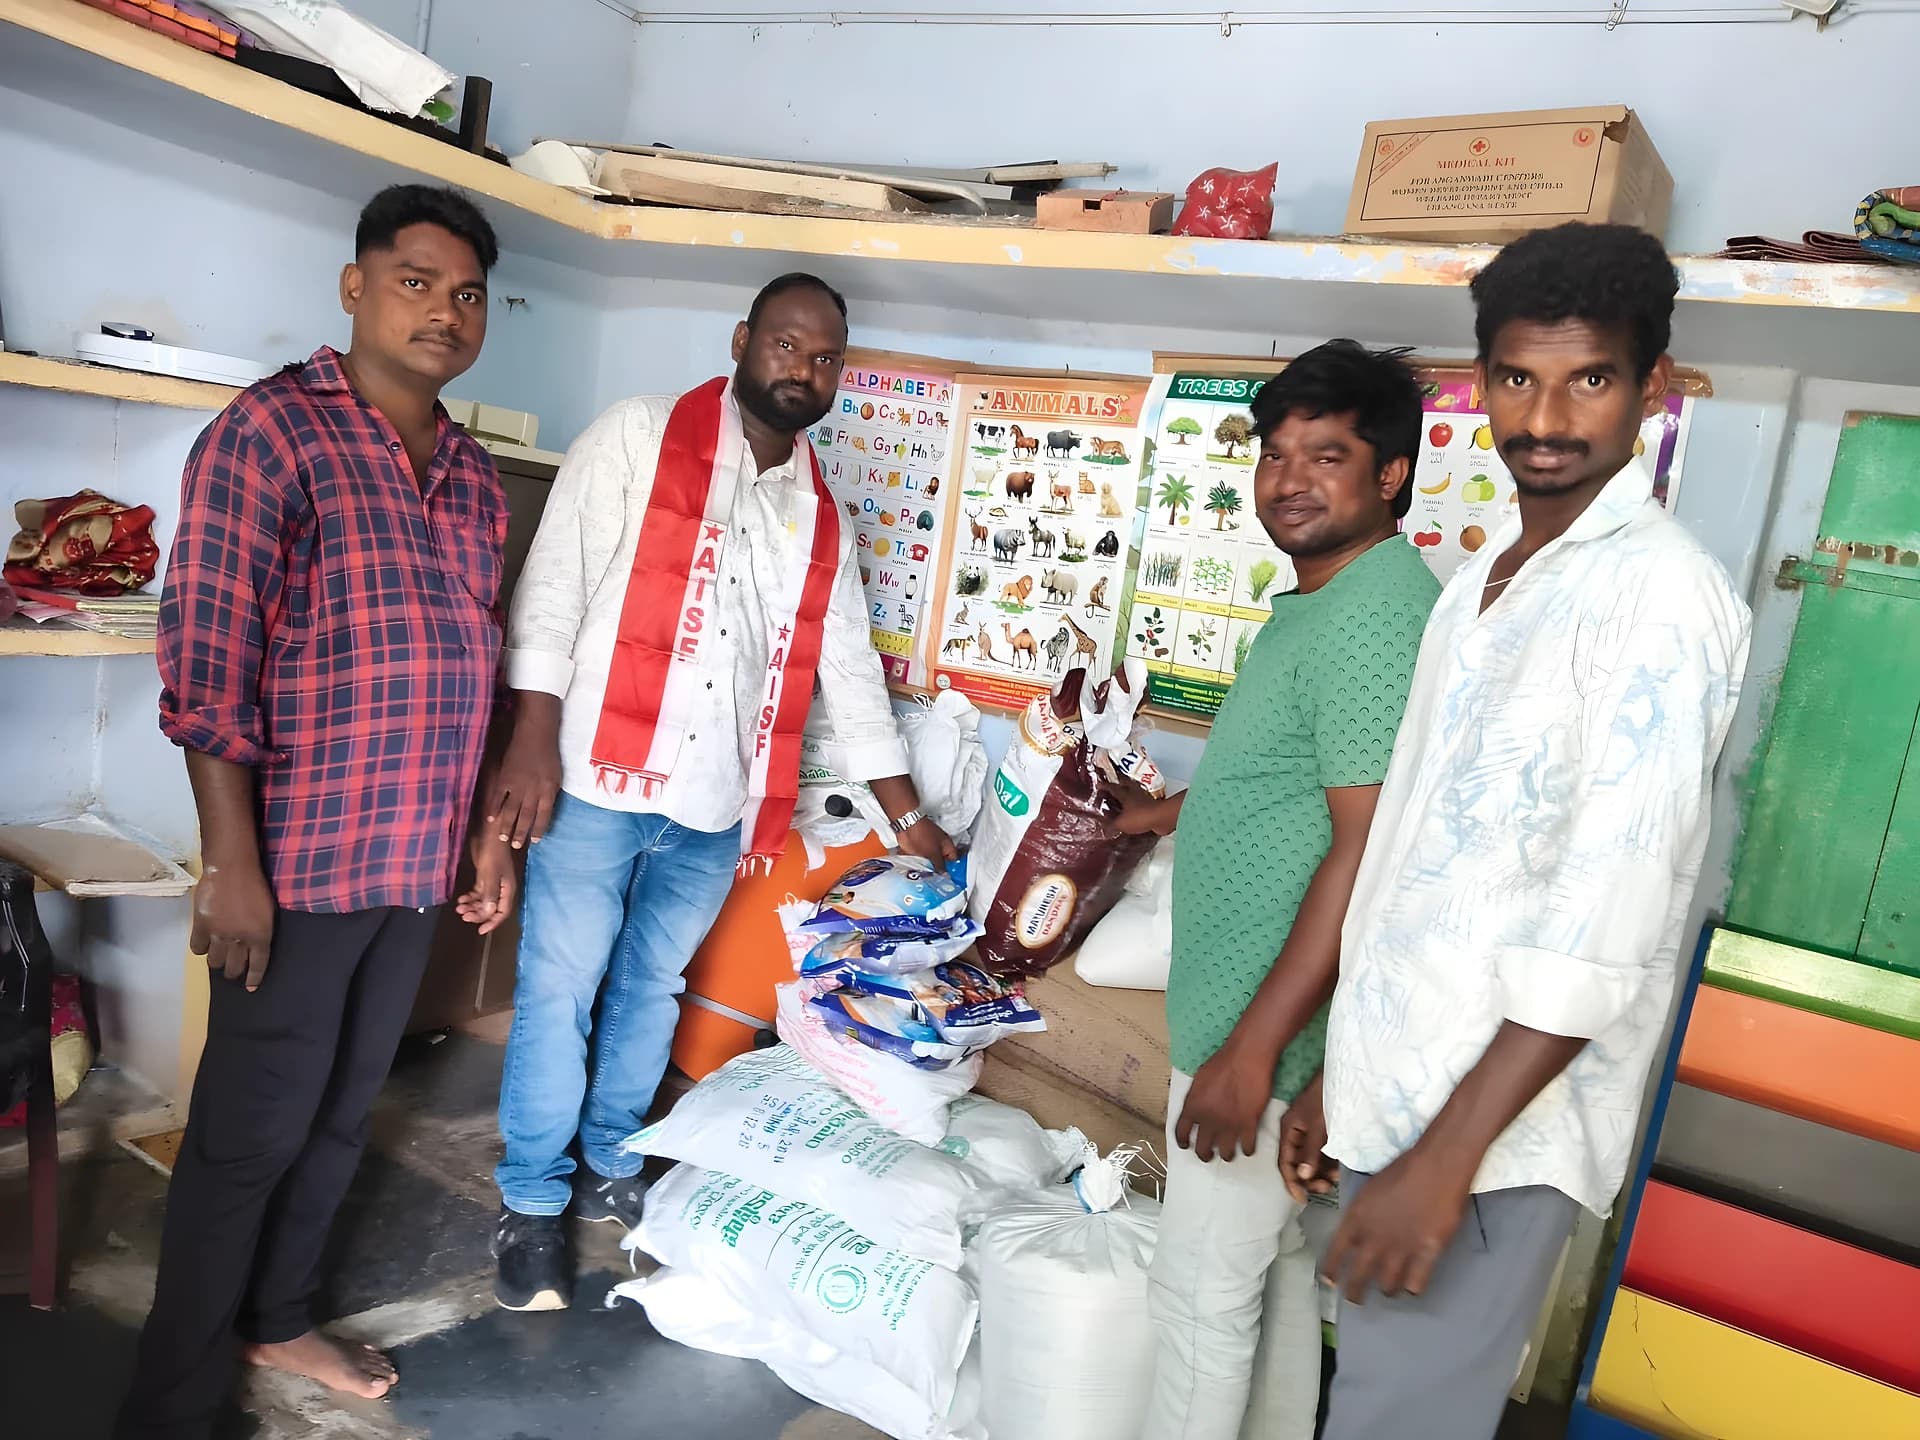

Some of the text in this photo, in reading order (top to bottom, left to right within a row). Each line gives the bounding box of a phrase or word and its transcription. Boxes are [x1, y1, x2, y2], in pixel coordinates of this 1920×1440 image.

[1437, 157, 1516, 169] MEDICAL KIT
[844, 371, 937, 397] ALPHABET
[1178, 379, 1248, 397] TREES
[842, 398, 858, 415] Bb
[879, 404, 896, 420] Cc
[990, 390, 1119, 417] ANIMALS
[918, 411, 933, 426] Dd
[873, 437, 891, 455] Gg
[911, 443, 927, 459] Hh
[868, 467, 885, 484] Kk
[900, 508, 915, 526] Pp
[873, 602, 887, 618] Zz
[755, 647, 784, 758] AISF
[995, 775, 1022, 809] Dal
